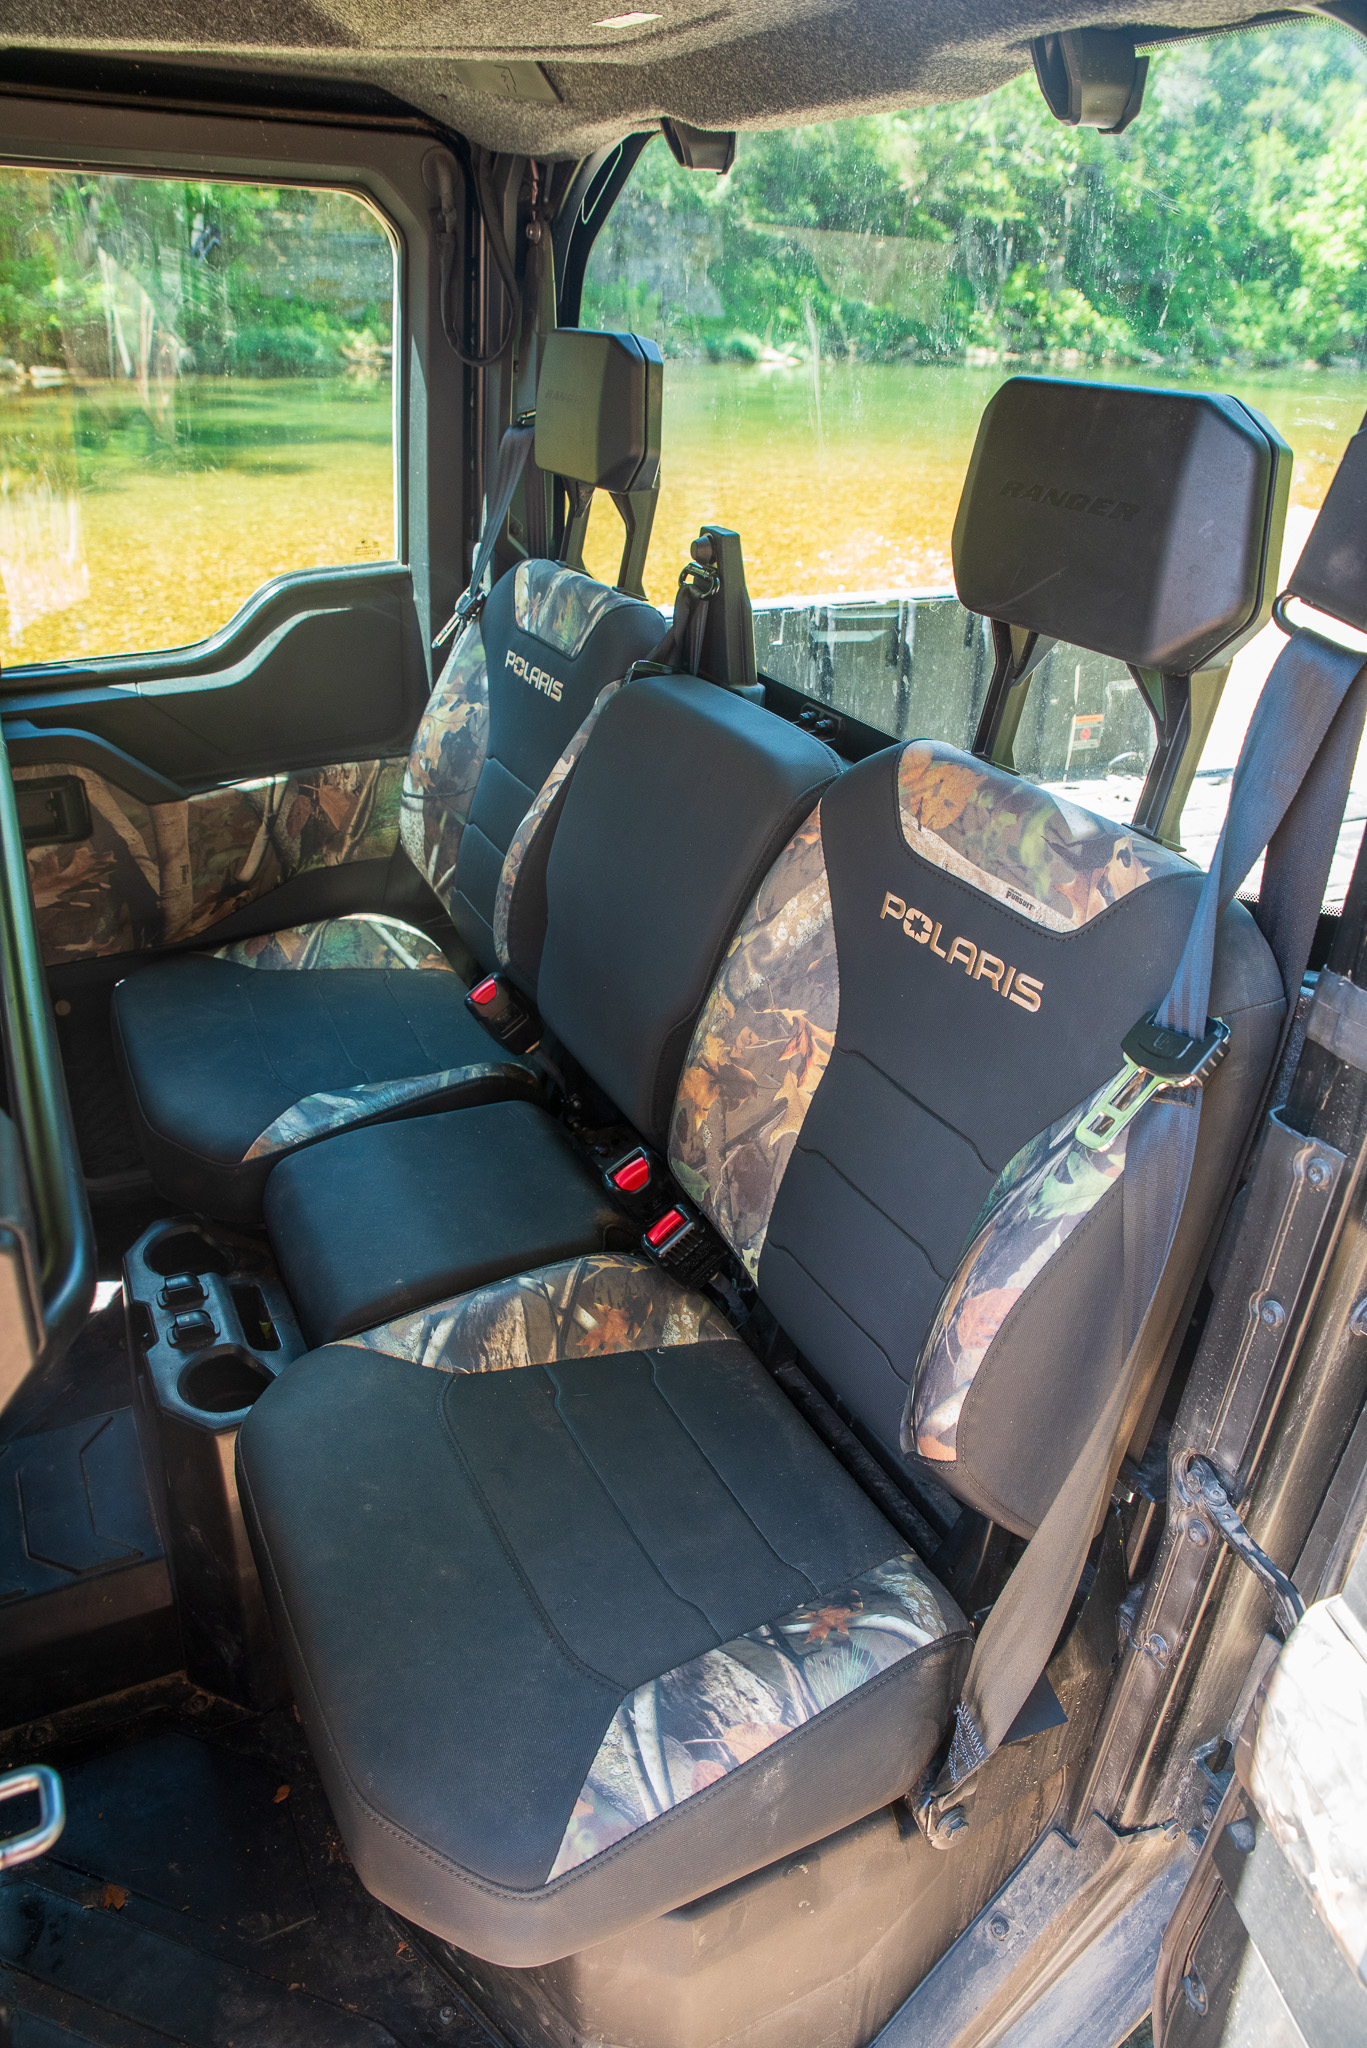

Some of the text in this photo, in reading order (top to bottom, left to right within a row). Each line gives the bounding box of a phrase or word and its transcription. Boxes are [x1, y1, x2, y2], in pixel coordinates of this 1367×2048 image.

[1000, 479, 1140, 522] RANGER
[504, 649, 564, 702] POLARIS
[1005, 890, 1034, 911] PURSUIT
[880, 891, 1044, 1013] POLARIS
